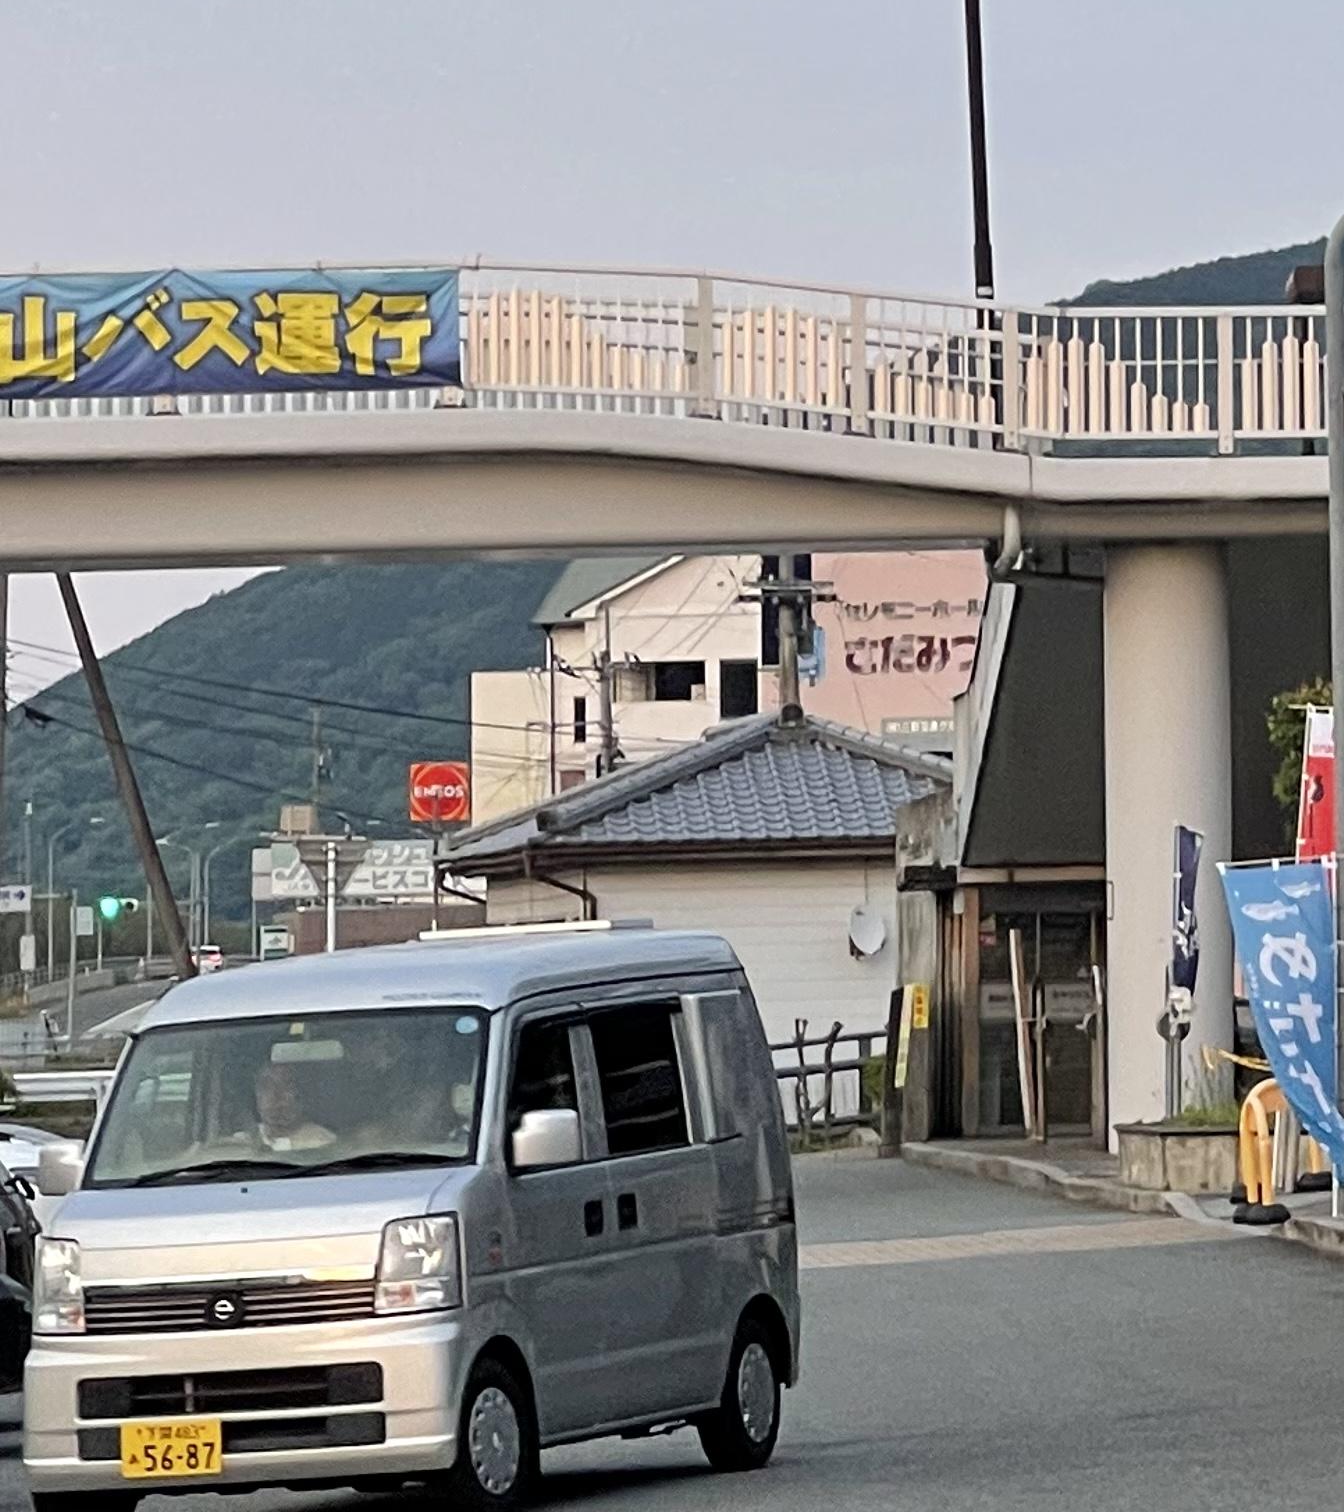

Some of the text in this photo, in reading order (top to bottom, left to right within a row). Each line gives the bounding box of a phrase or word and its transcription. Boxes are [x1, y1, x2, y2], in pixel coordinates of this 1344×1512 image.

[0, 289, 431, 384] 山バス運行
[143, 1442, 215, 1472] 56-87
